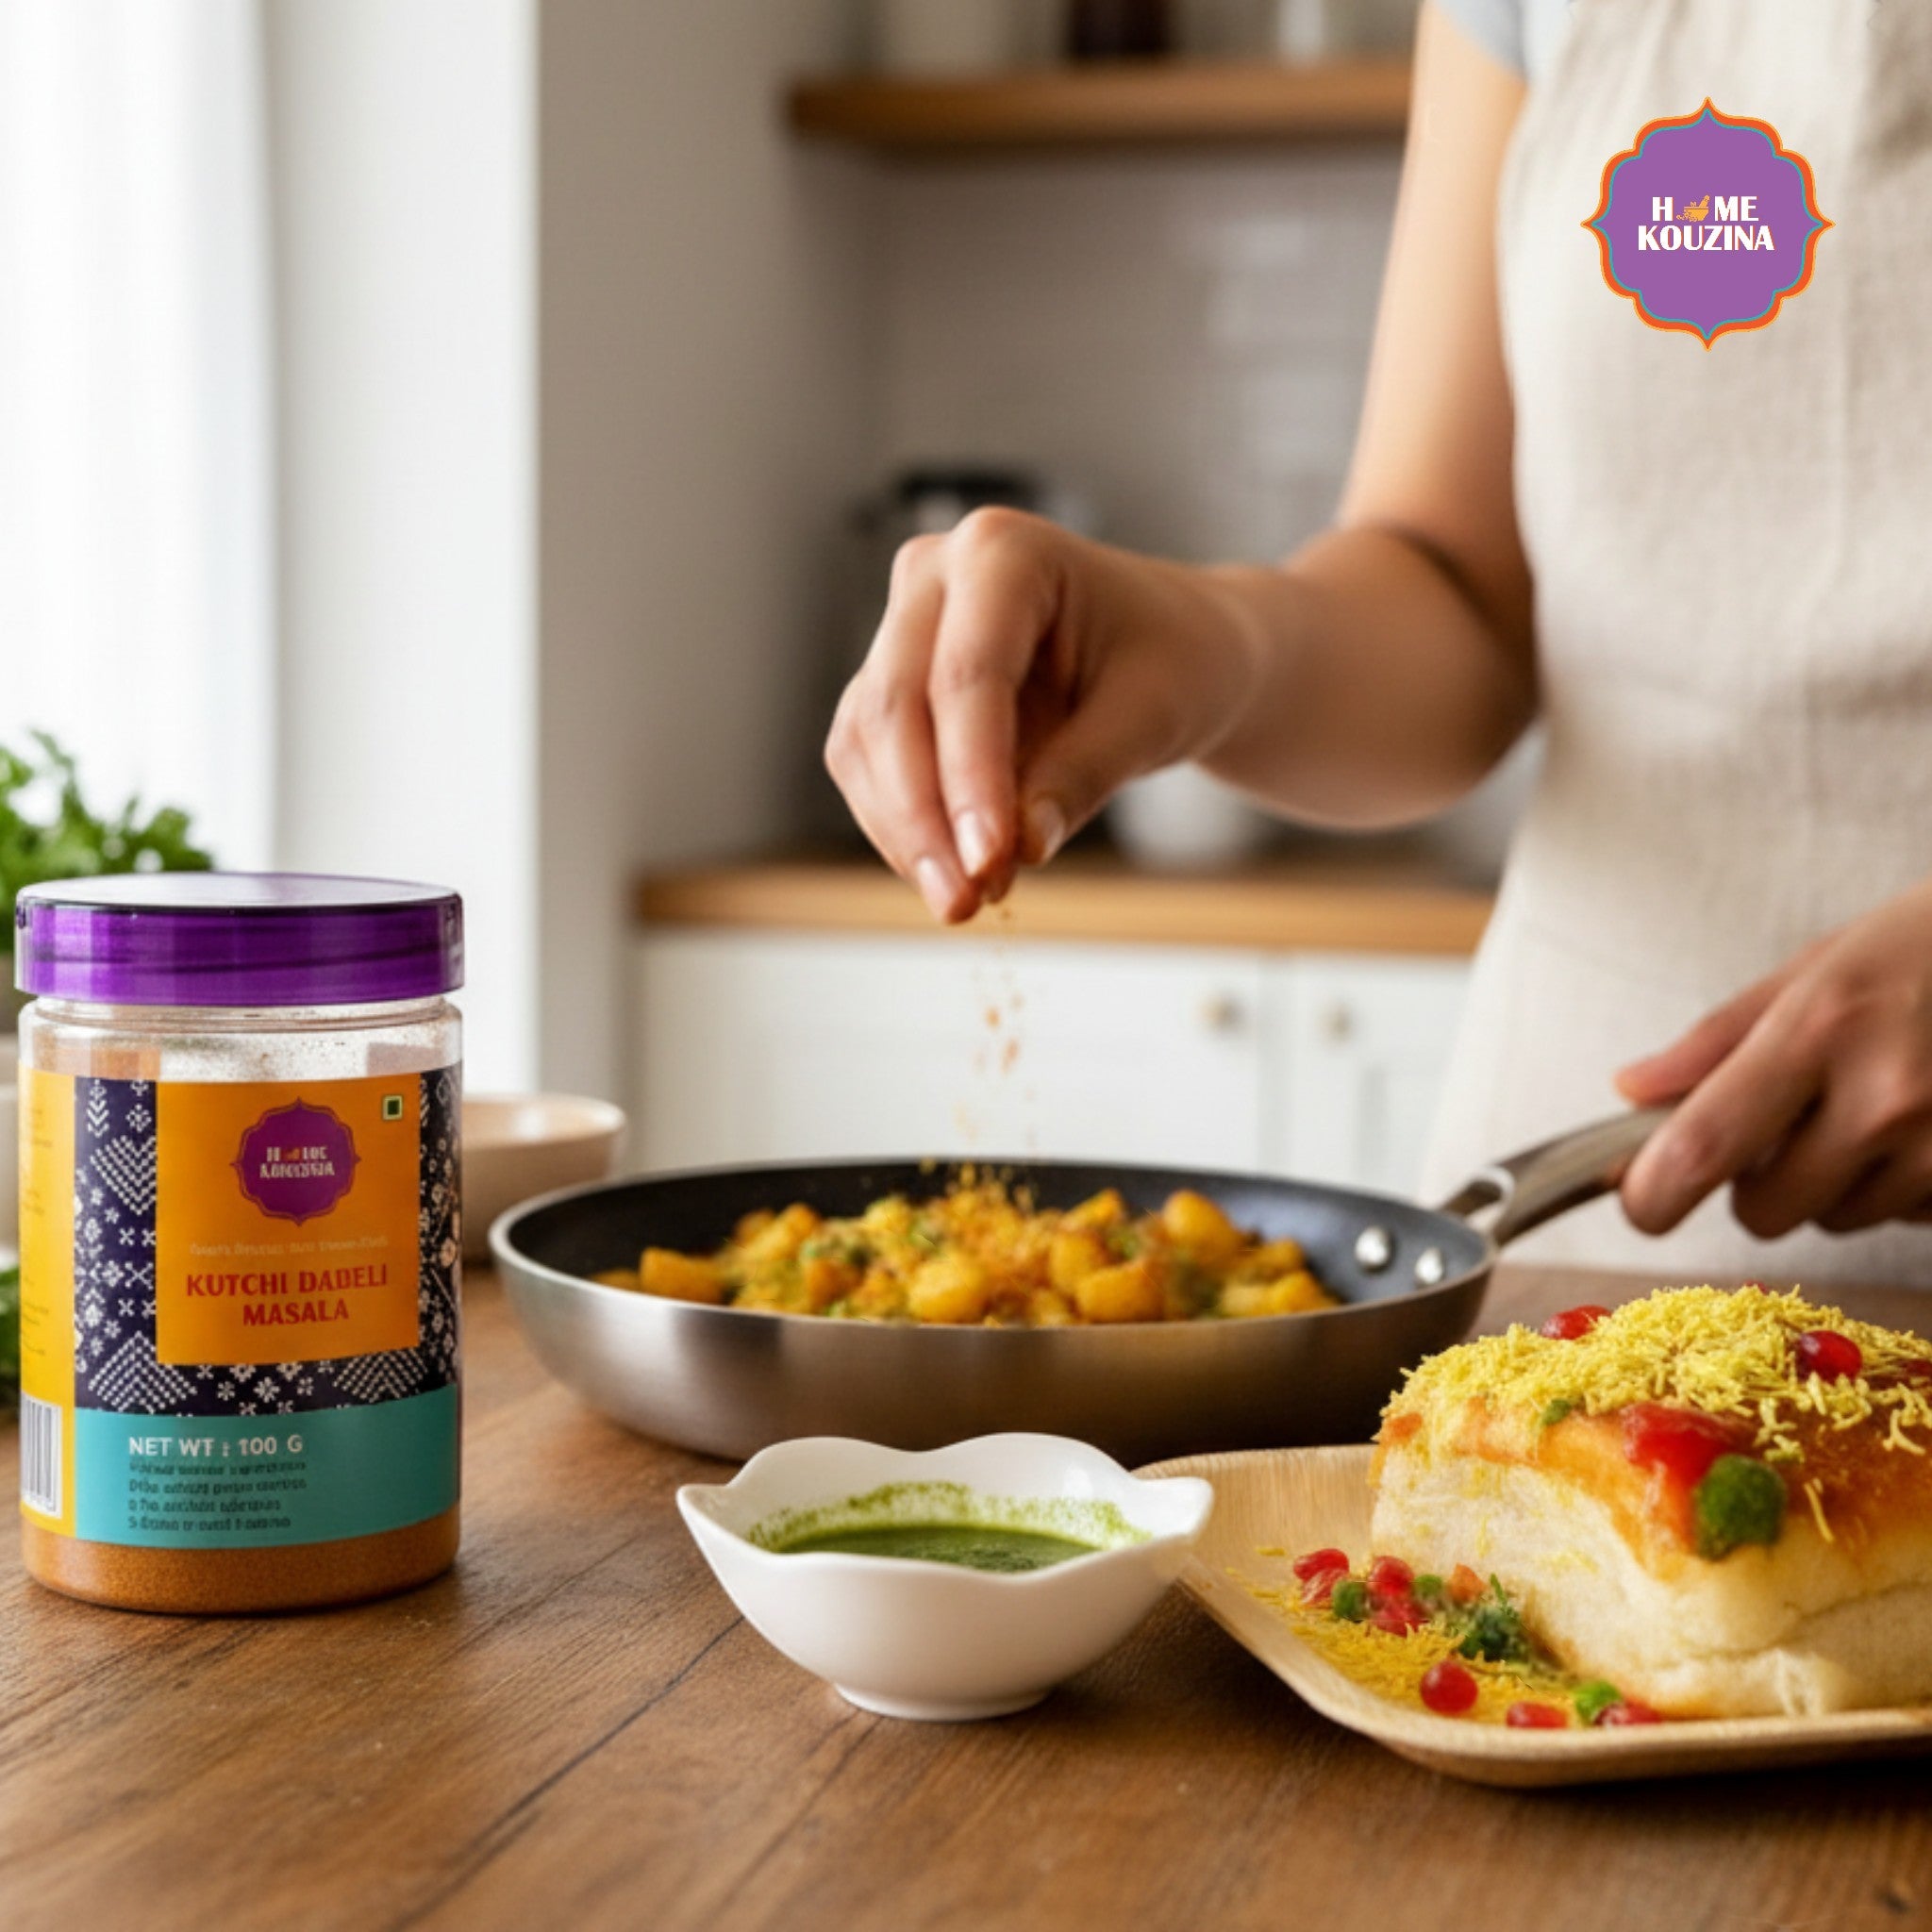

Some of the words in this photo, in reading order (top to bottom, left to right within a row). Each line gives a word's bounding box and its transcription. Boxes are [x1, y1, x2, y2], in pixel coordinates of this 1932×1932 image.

[187, 1273, 289, 1296] KUTCHI
[242, 1298, 350, 1325] MASALA
[128, 1437, 173, 1457] NET
[178, 1438, 214, 1457] WT
[239, 1436, 277, 1456] 100
[287, 1434, 304, 1453] G
